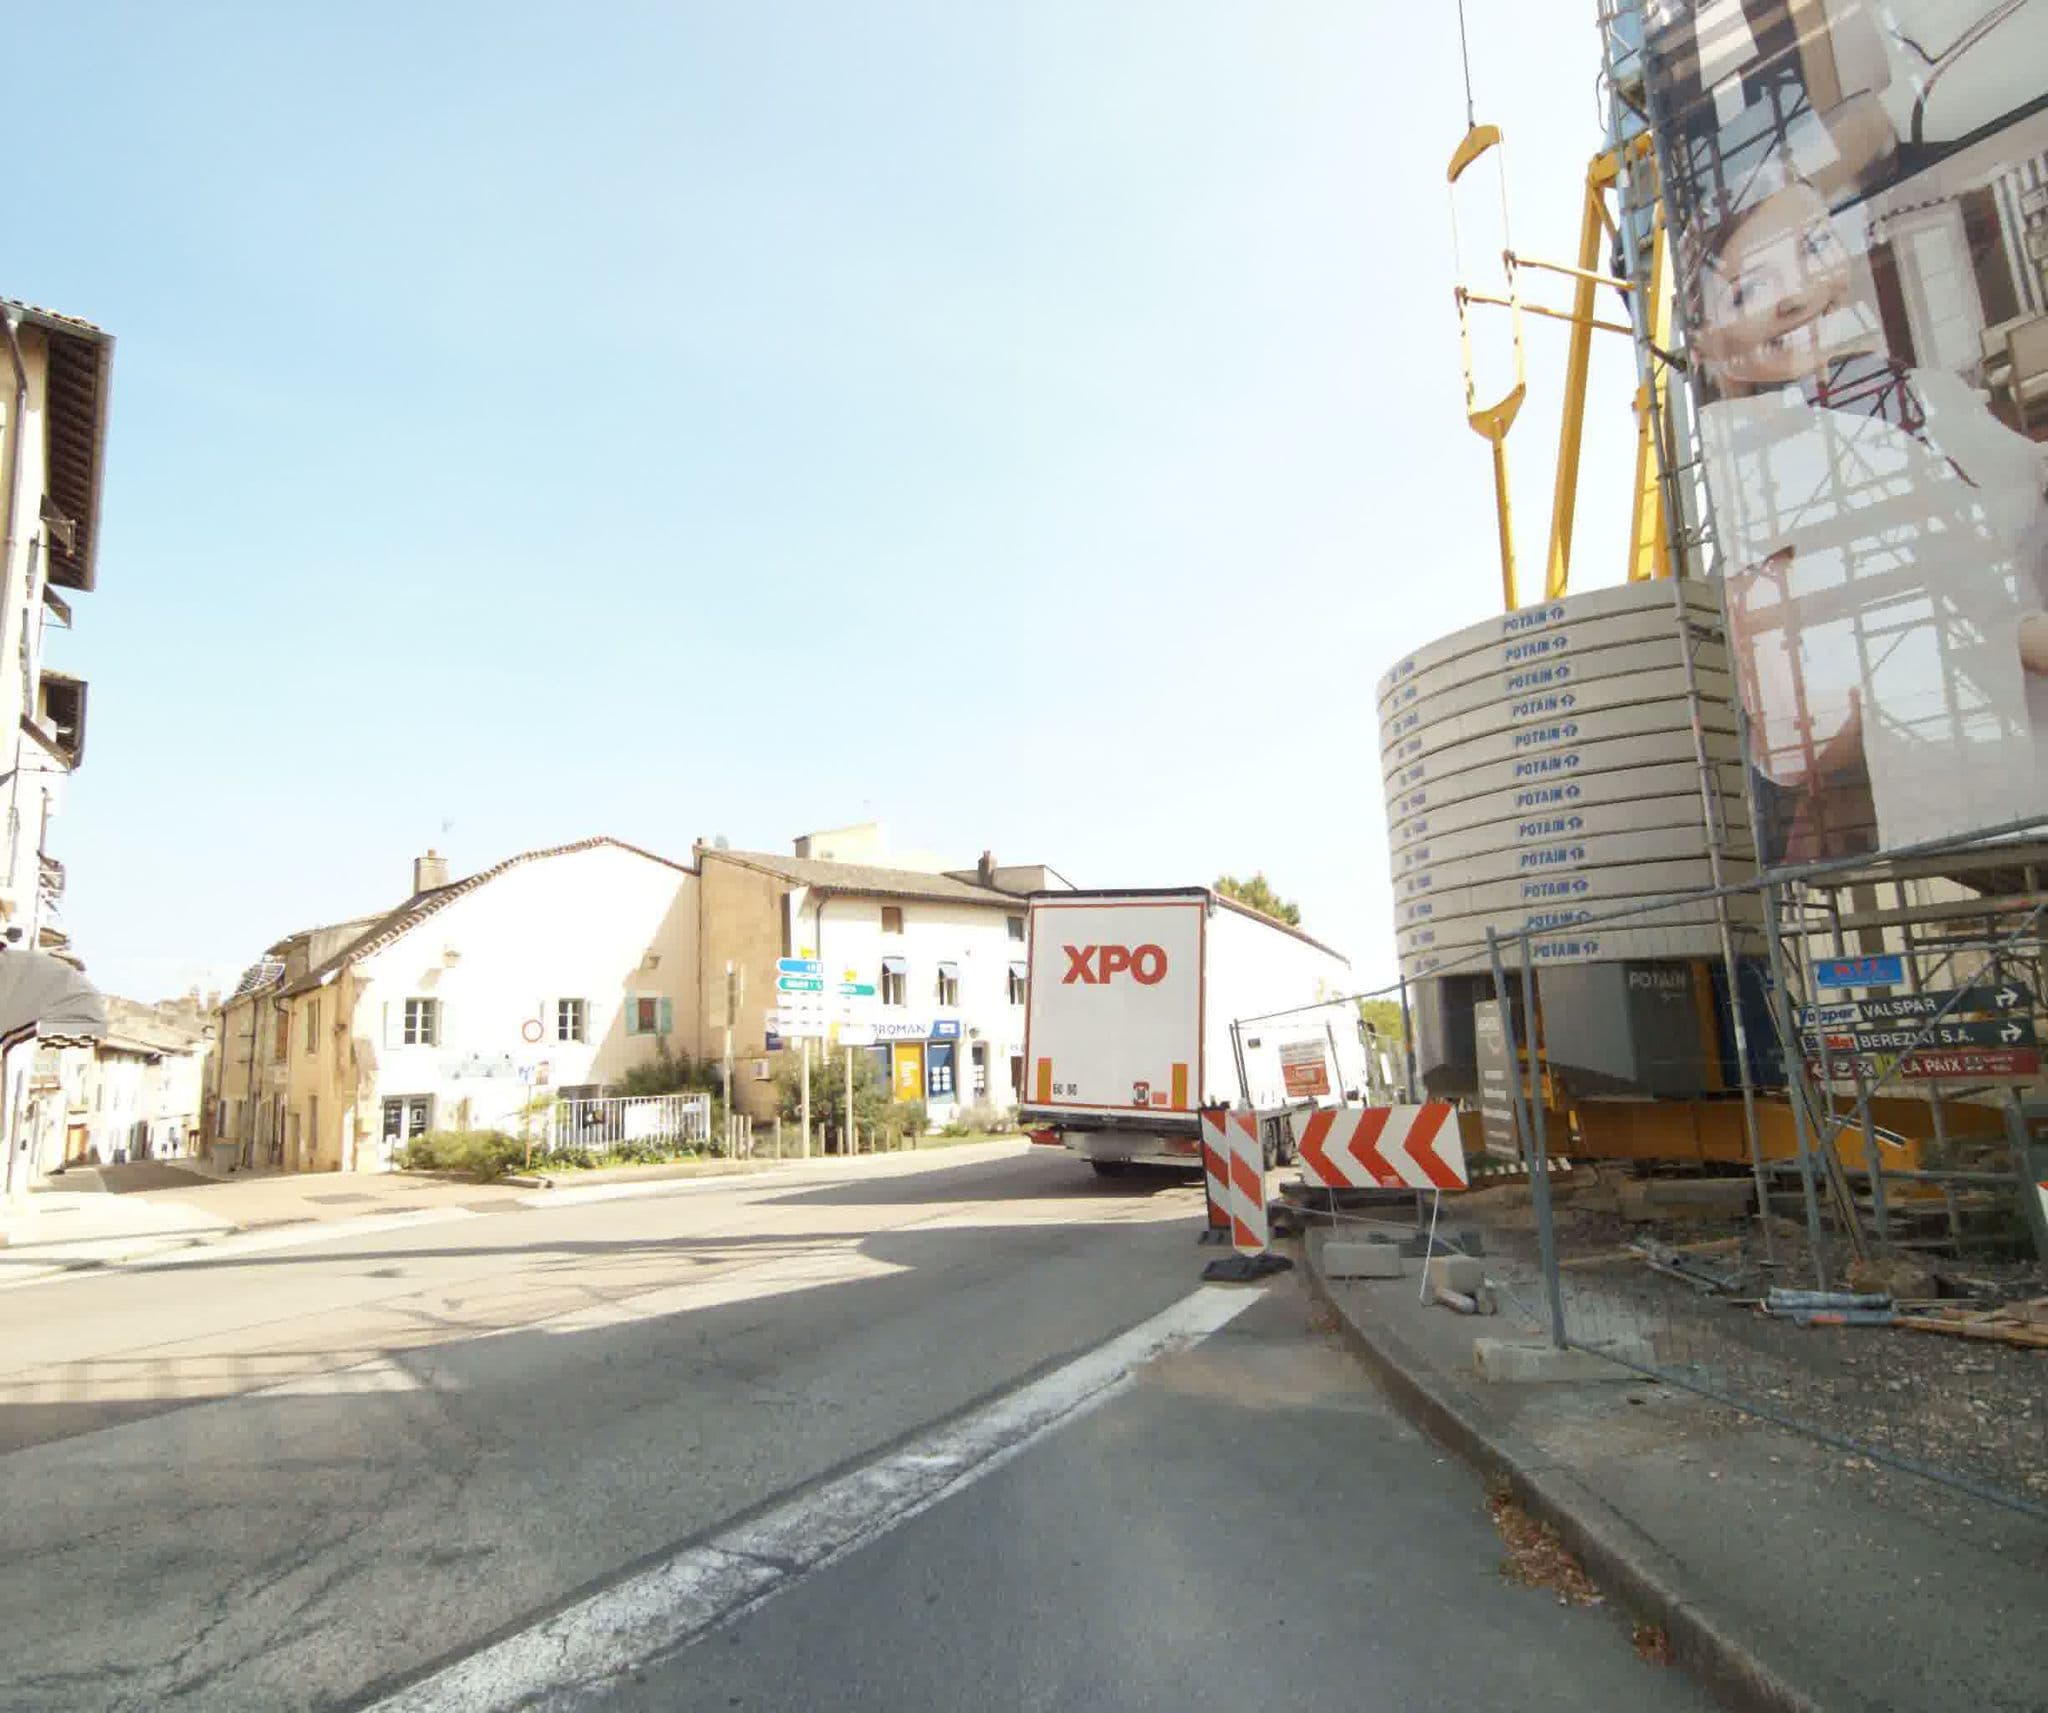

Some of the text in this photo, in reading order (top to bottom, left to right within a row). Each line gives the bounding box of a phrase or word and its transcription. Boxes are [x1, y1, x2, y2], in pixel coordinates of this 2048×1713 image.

[1504, 611, 1547, 632] POTAIN
[1506, 640, 1549, 661] POTAIN
[1508, 669, 1552, 690] POTAIN
[1513, 696, 1557, 716] POTAIN
[1515, 727, 1560, 747] POTAIN
[1516, 757, 1561, 776] POTAIN
[1518, 789, 1562, 806] POTAIN
[1520, 820, 1565, 837] POTAIN
[1521, 849, 1566, 866] POTAIN
[1524, 882, 1569, 897] POTAIN
[1527, 911, 1573, 929] POTAIN
[1535, 943, 1580, 958] POTAIN
[1062, 944, 1167, 985] XPO
[1863, 999, 1937, 1018] VALSPAR
[1940, 1028, 1974, 1043] S.A.
[1901, 1061, 1921, 1074] LA
[1924, 1058, 1962, 1073] PAIX
